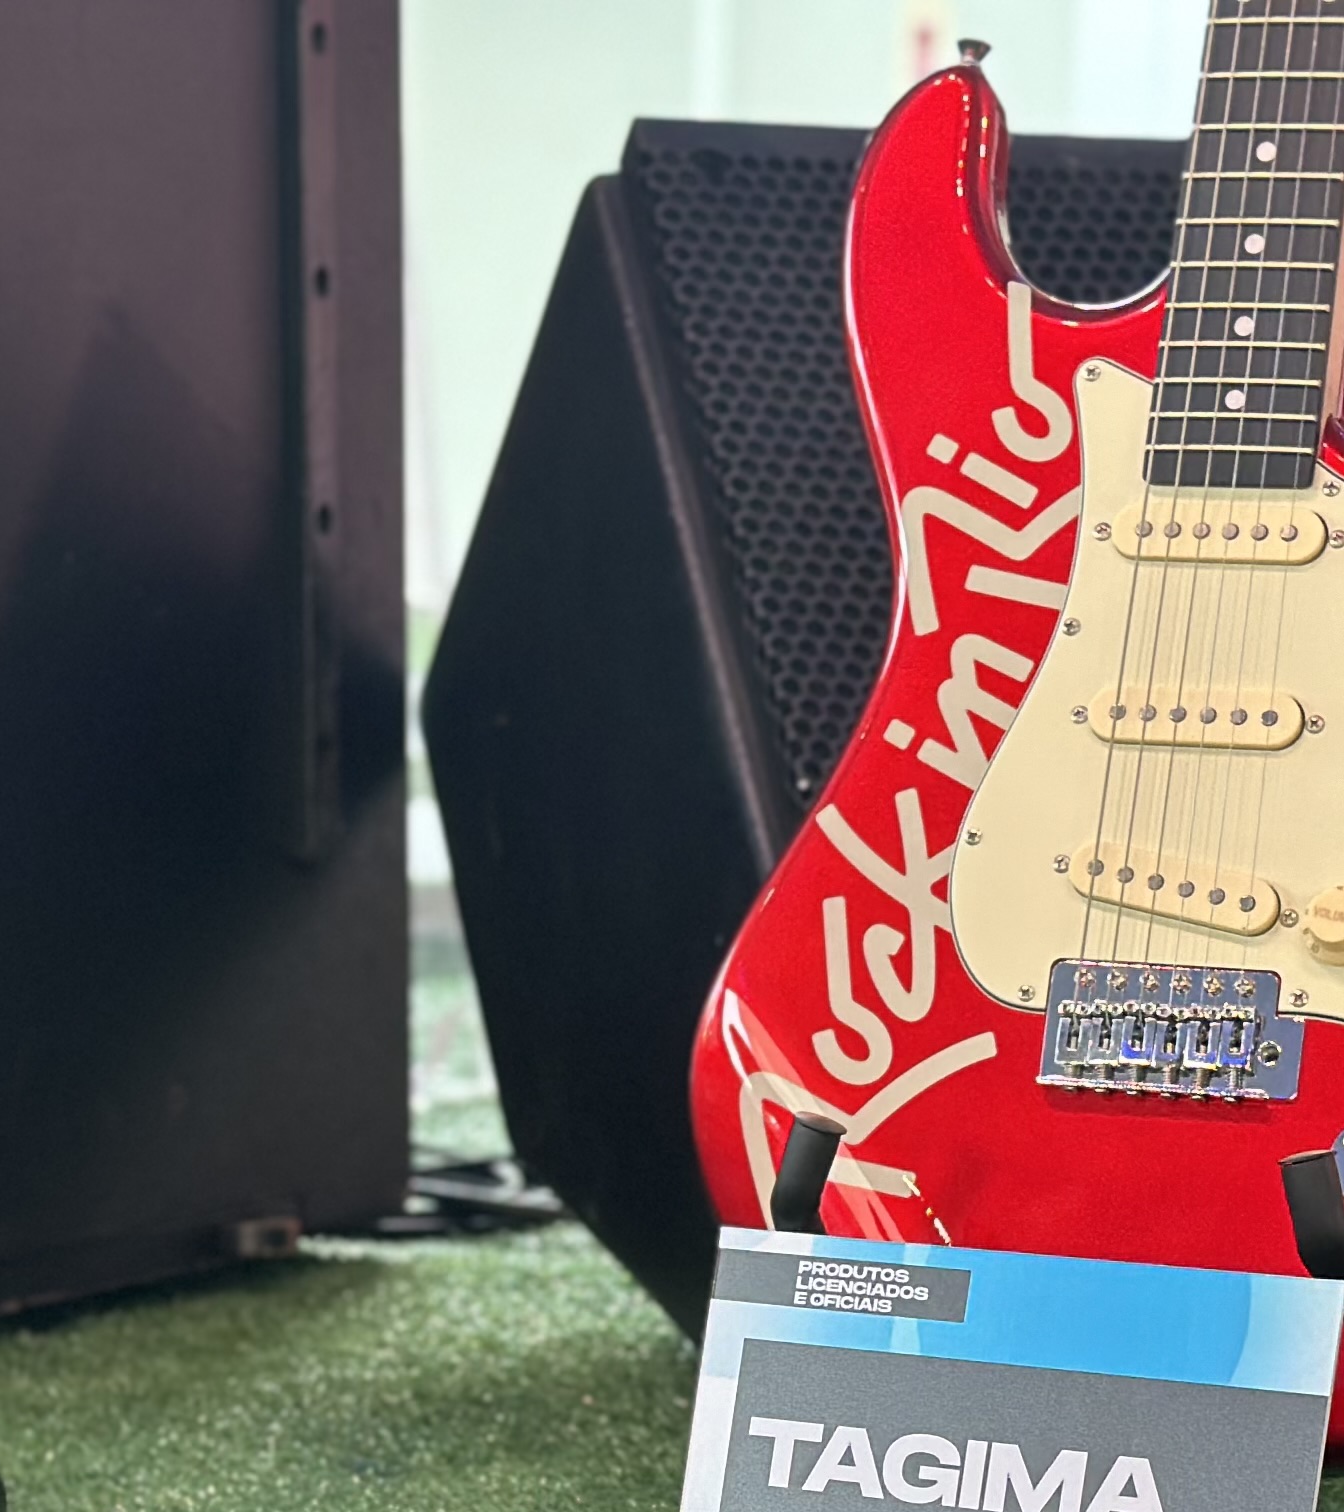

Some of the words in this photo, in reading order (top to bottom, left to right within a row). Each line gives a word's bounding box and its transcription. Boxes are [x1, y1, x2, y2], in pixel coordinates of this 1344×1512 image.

[900, 280, 1083, 637] Rio
[882, 633, 1035, 792] in
[739, 787, 998, 1231] Rock
[793, 1291, 807, 1305] E
[809, 1293, 892, 1313] OFICIAIS
[795, 1275, 929, 1301] LICENCIADOS
[798, 1260, 910, 1283] PRODUTOS
